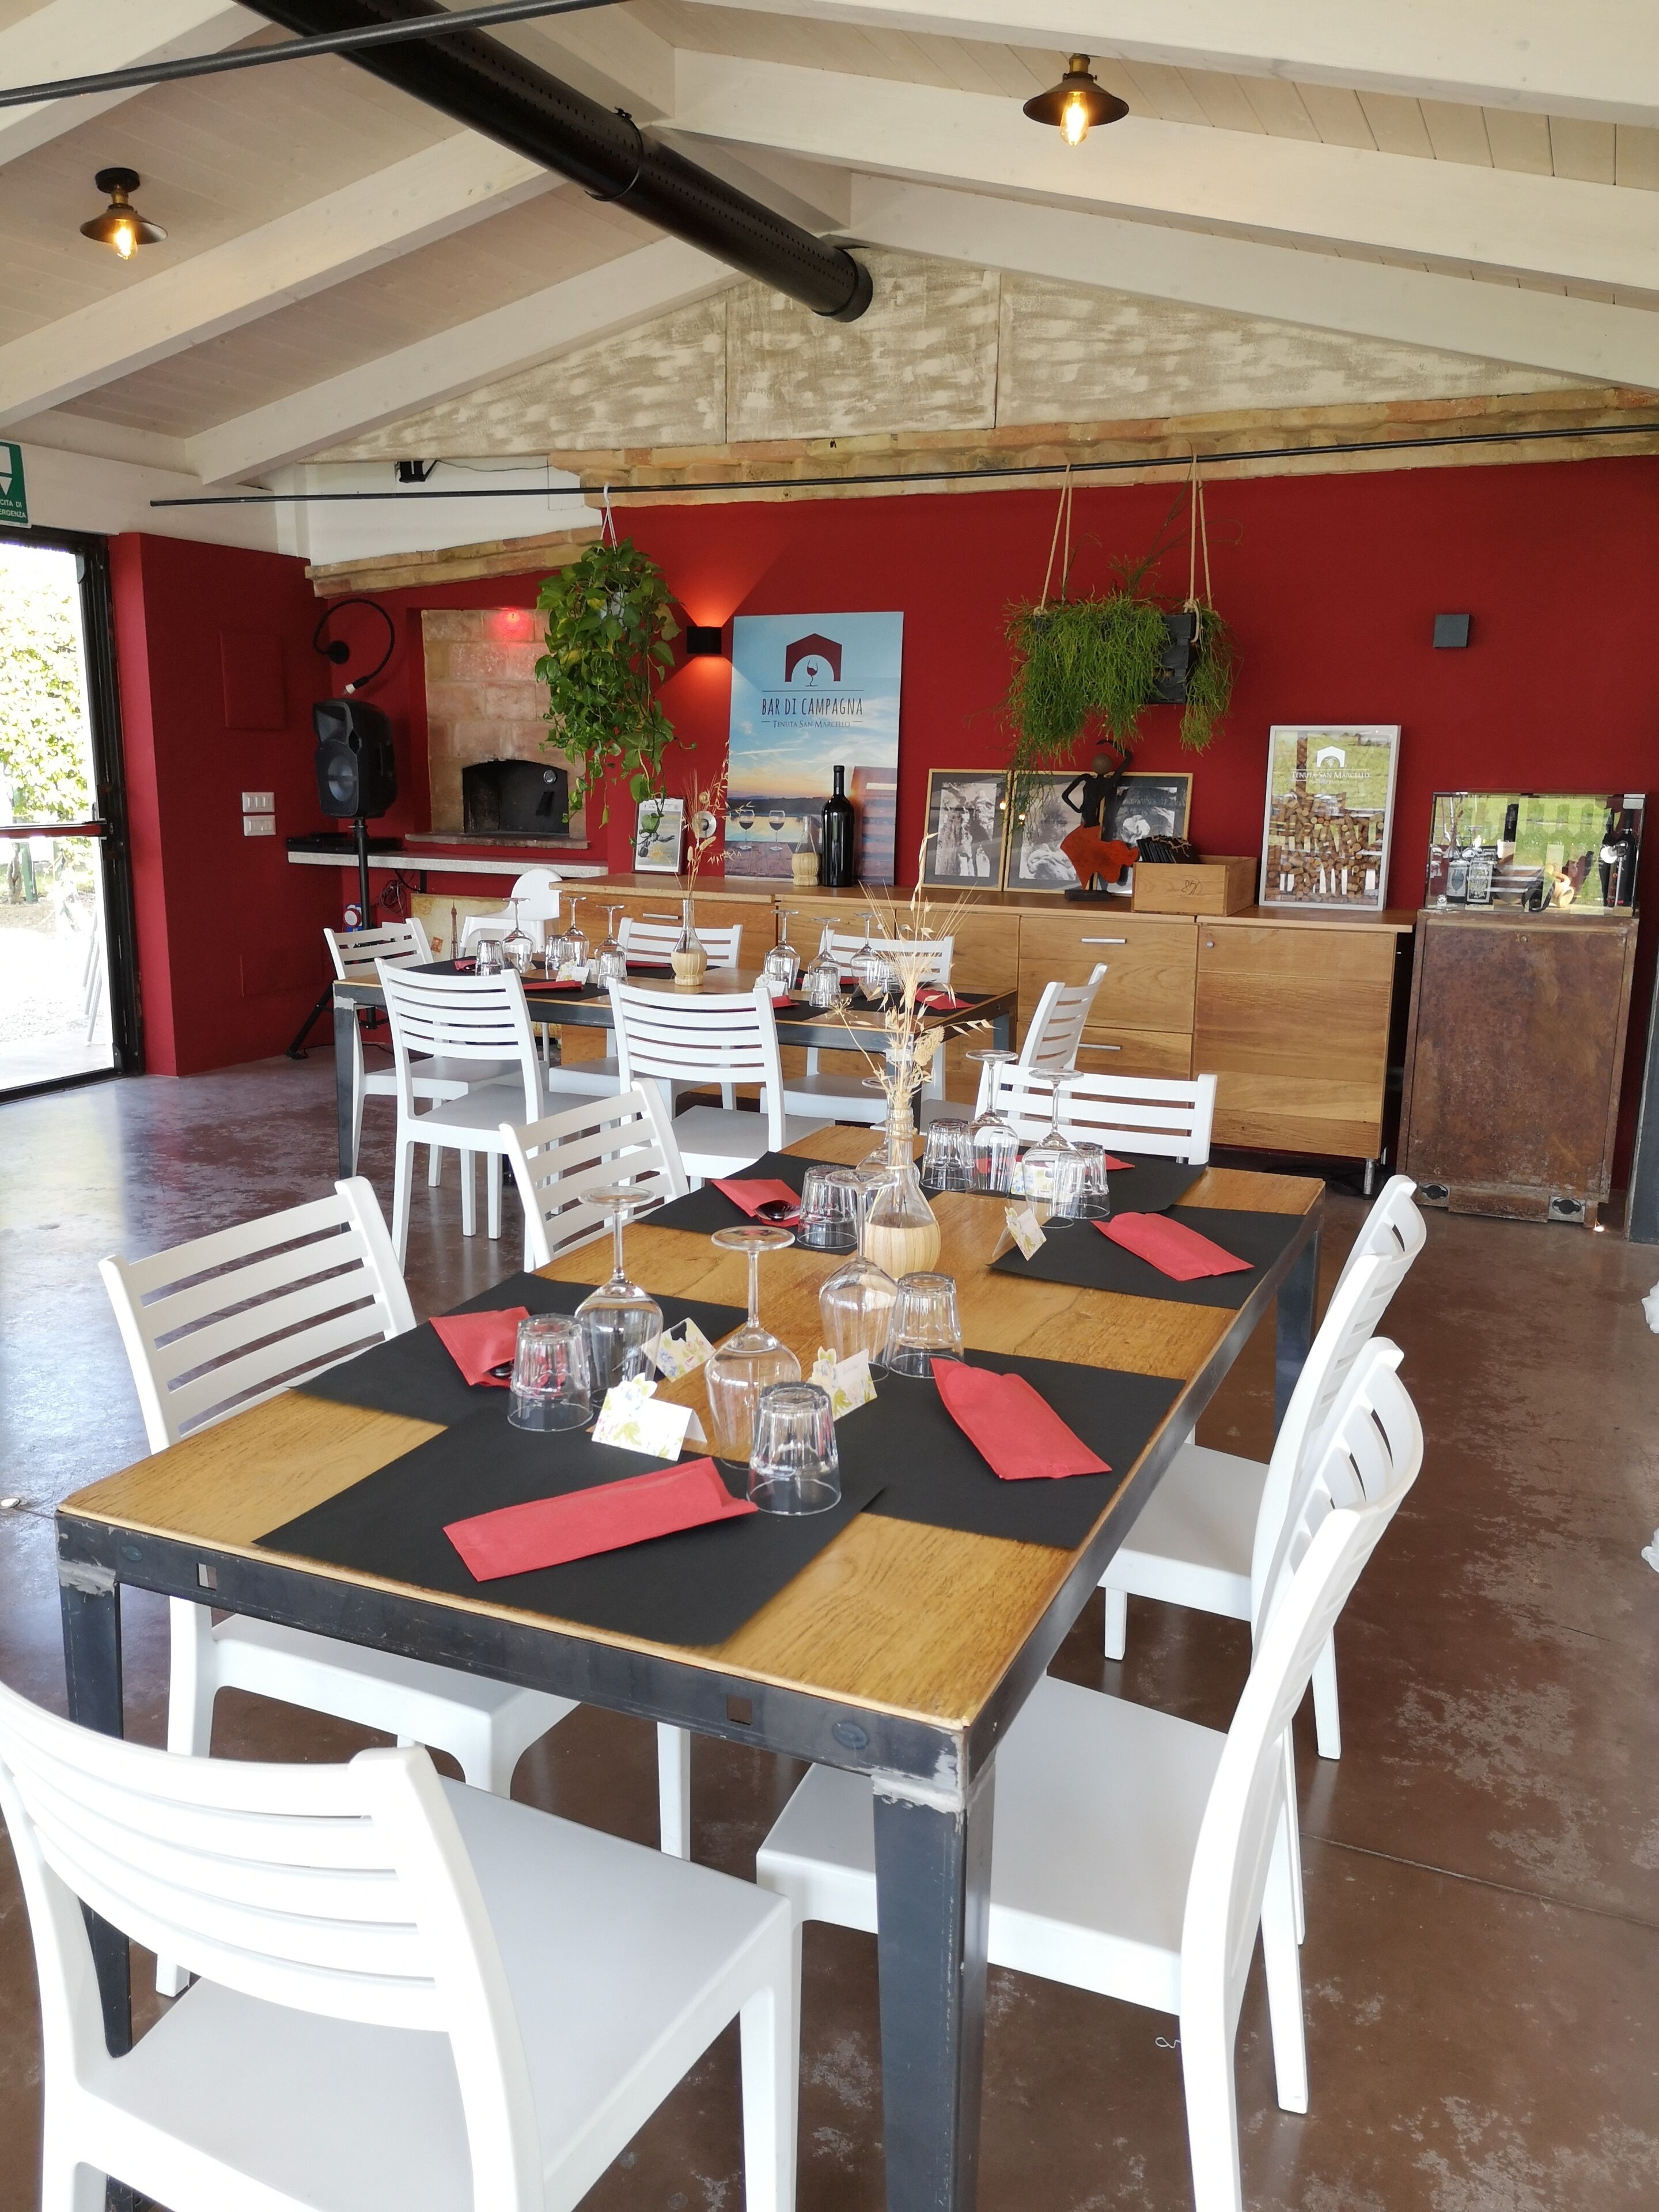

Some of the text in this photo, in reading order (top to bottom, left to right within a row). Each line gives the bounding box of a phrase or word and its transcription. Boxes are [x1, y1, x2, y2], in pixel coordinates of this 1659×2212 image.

[762, 698, 862, 715] BAR DI CAMPAGNA
